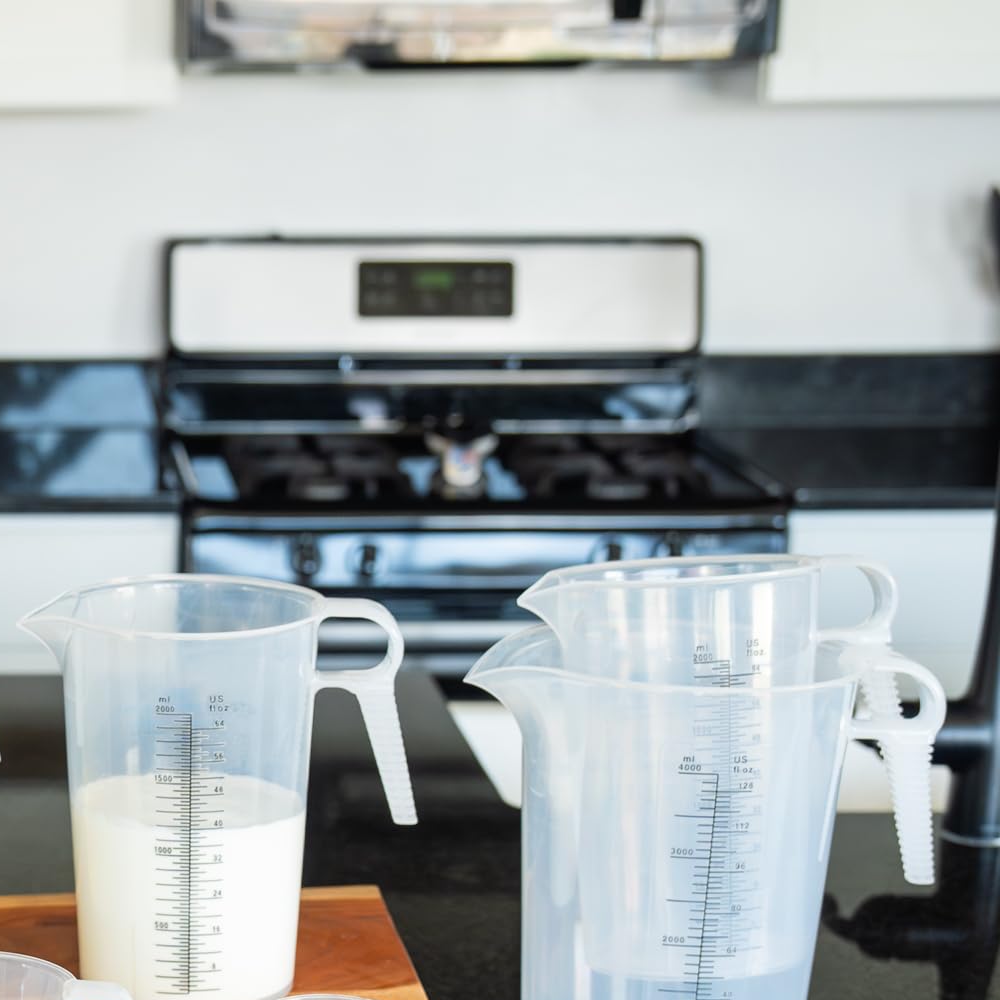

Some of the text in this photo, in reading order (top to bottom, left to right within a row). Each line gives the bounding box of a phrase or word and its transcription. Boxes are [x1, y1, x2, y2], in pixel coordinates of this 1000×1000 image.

[696, 644, 708, 652] ml
[746, 640, 759, 648] US
[693, 654, 712, 662] 2000
[209, 695, 224, 703] US
[734, 756, 748, 764] US
[678, 764, 702, 772] 4000
[739, 782, 754, 790] 128
[154, 846, 172, 854] 1000
[670, 848, 694, 856] 3000
